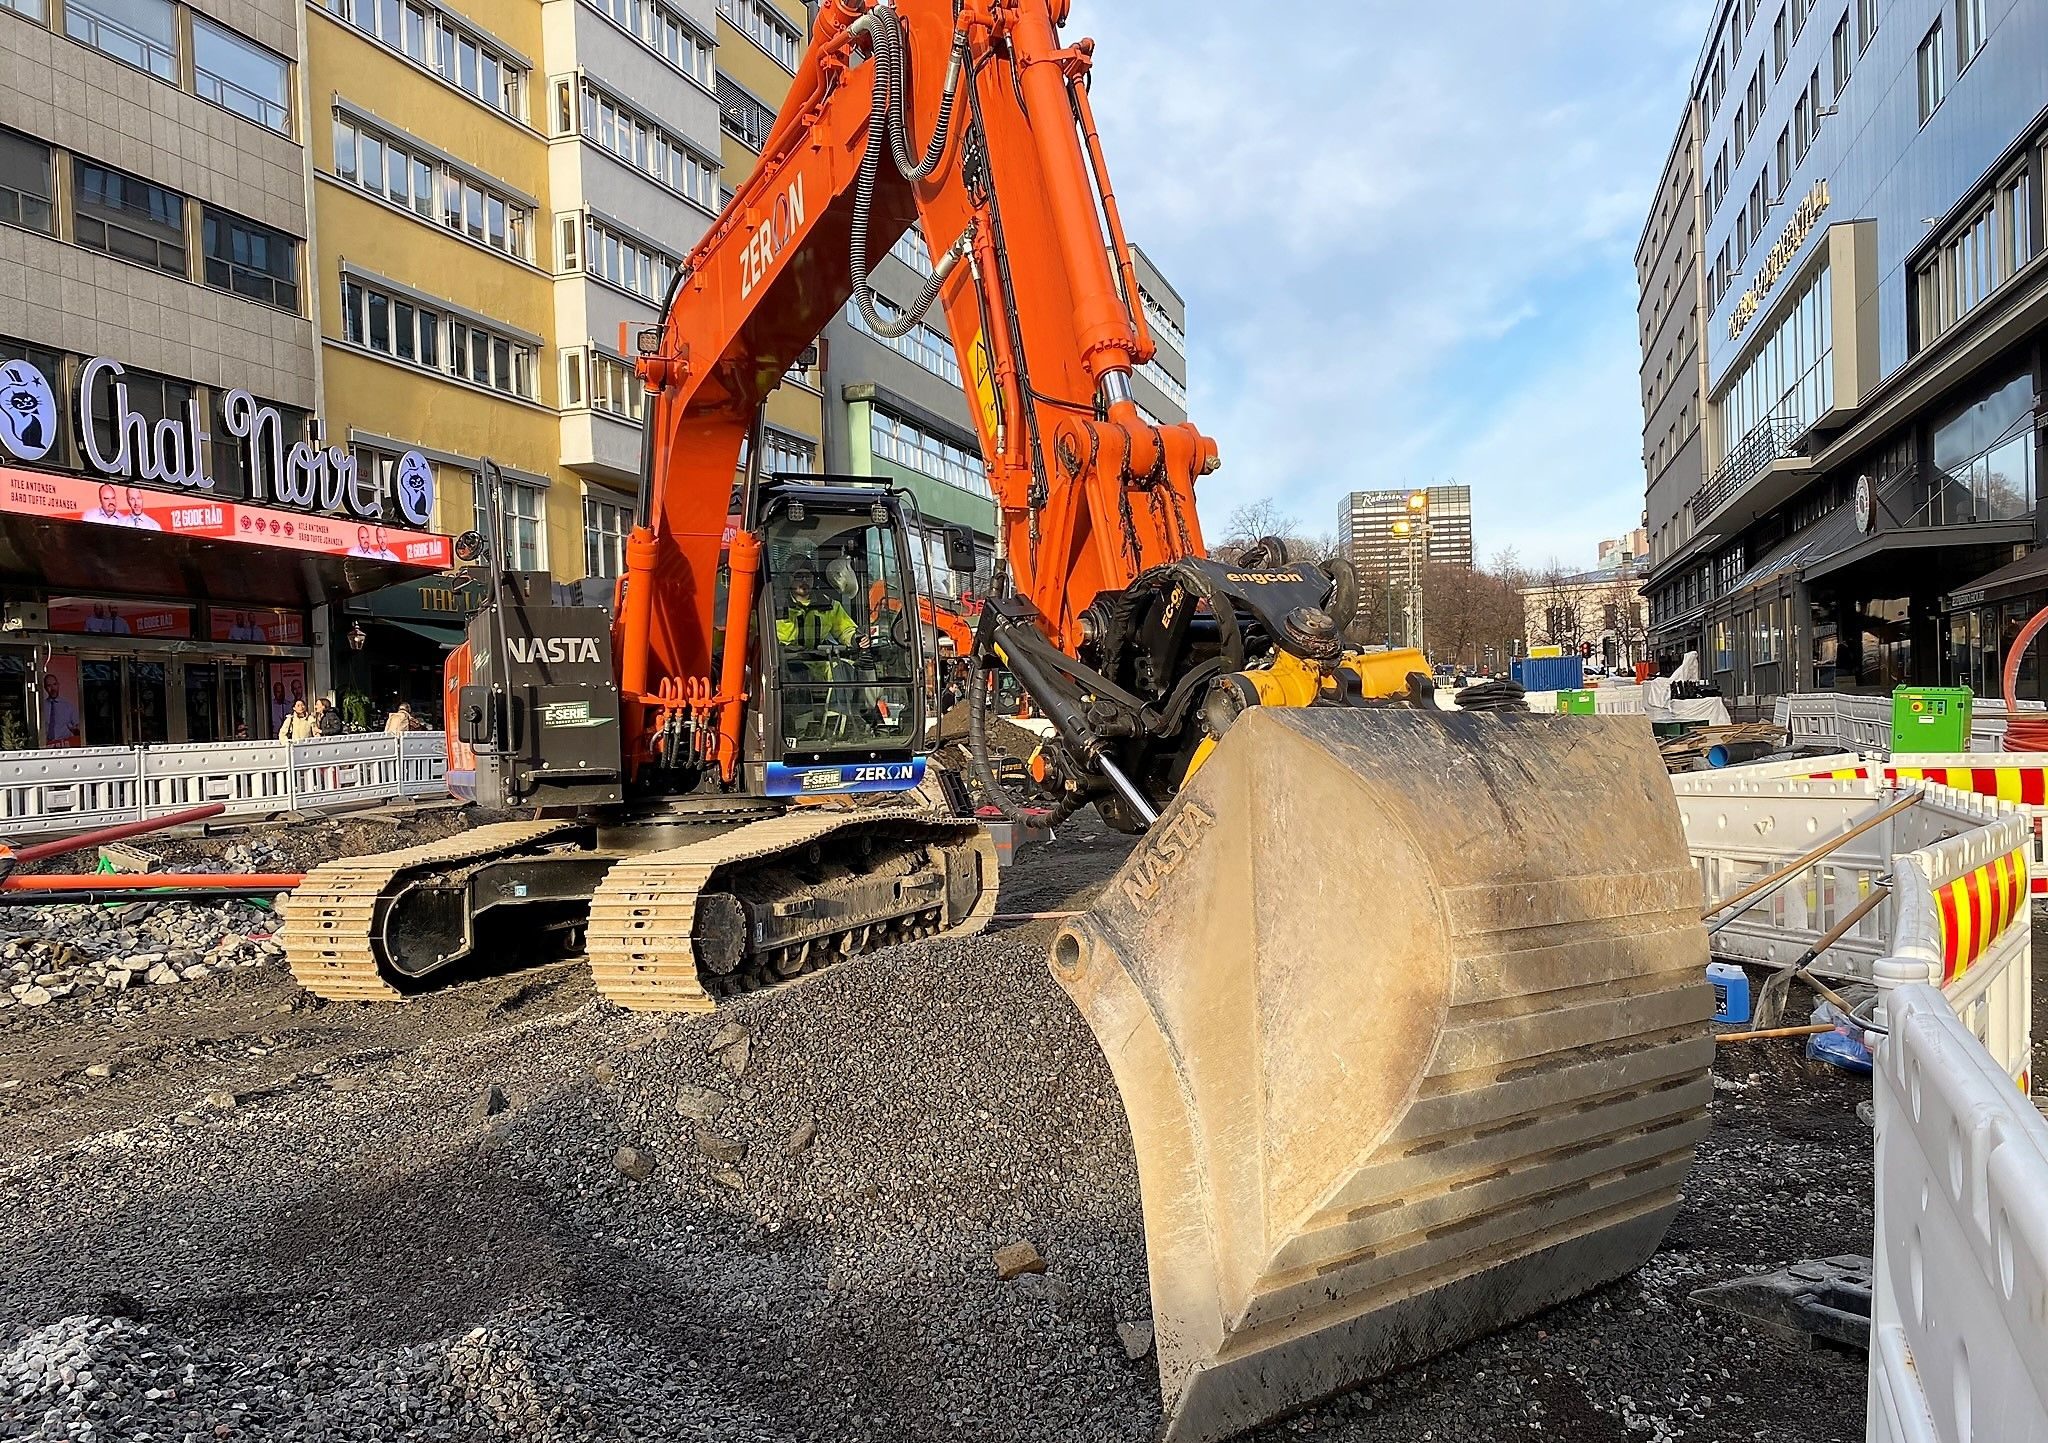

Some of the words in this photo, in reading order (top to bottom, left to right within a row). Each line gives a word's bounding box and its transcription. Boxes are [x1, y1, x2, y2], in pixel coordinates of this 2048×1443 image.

[78, 357, 215, 488] Chat
[225, 387, 383, 516] Noir
[26, 482, 56, 494] ANTONSEN
[1361, 492, 1403, 507] Radisson
[171, 511, 181, 528] 12
[182, 509, 204, 526] GODE
[204, 504, 223, 525] RÅD
[1226, 572, 1304, 585] engcon
[417, 587, 459, 613] THE
[545, 707, 588, 721] E-SERIE
[802, 773, 840, 786] E-SERIE
[1122, 802, 1216, 911] NASTA
